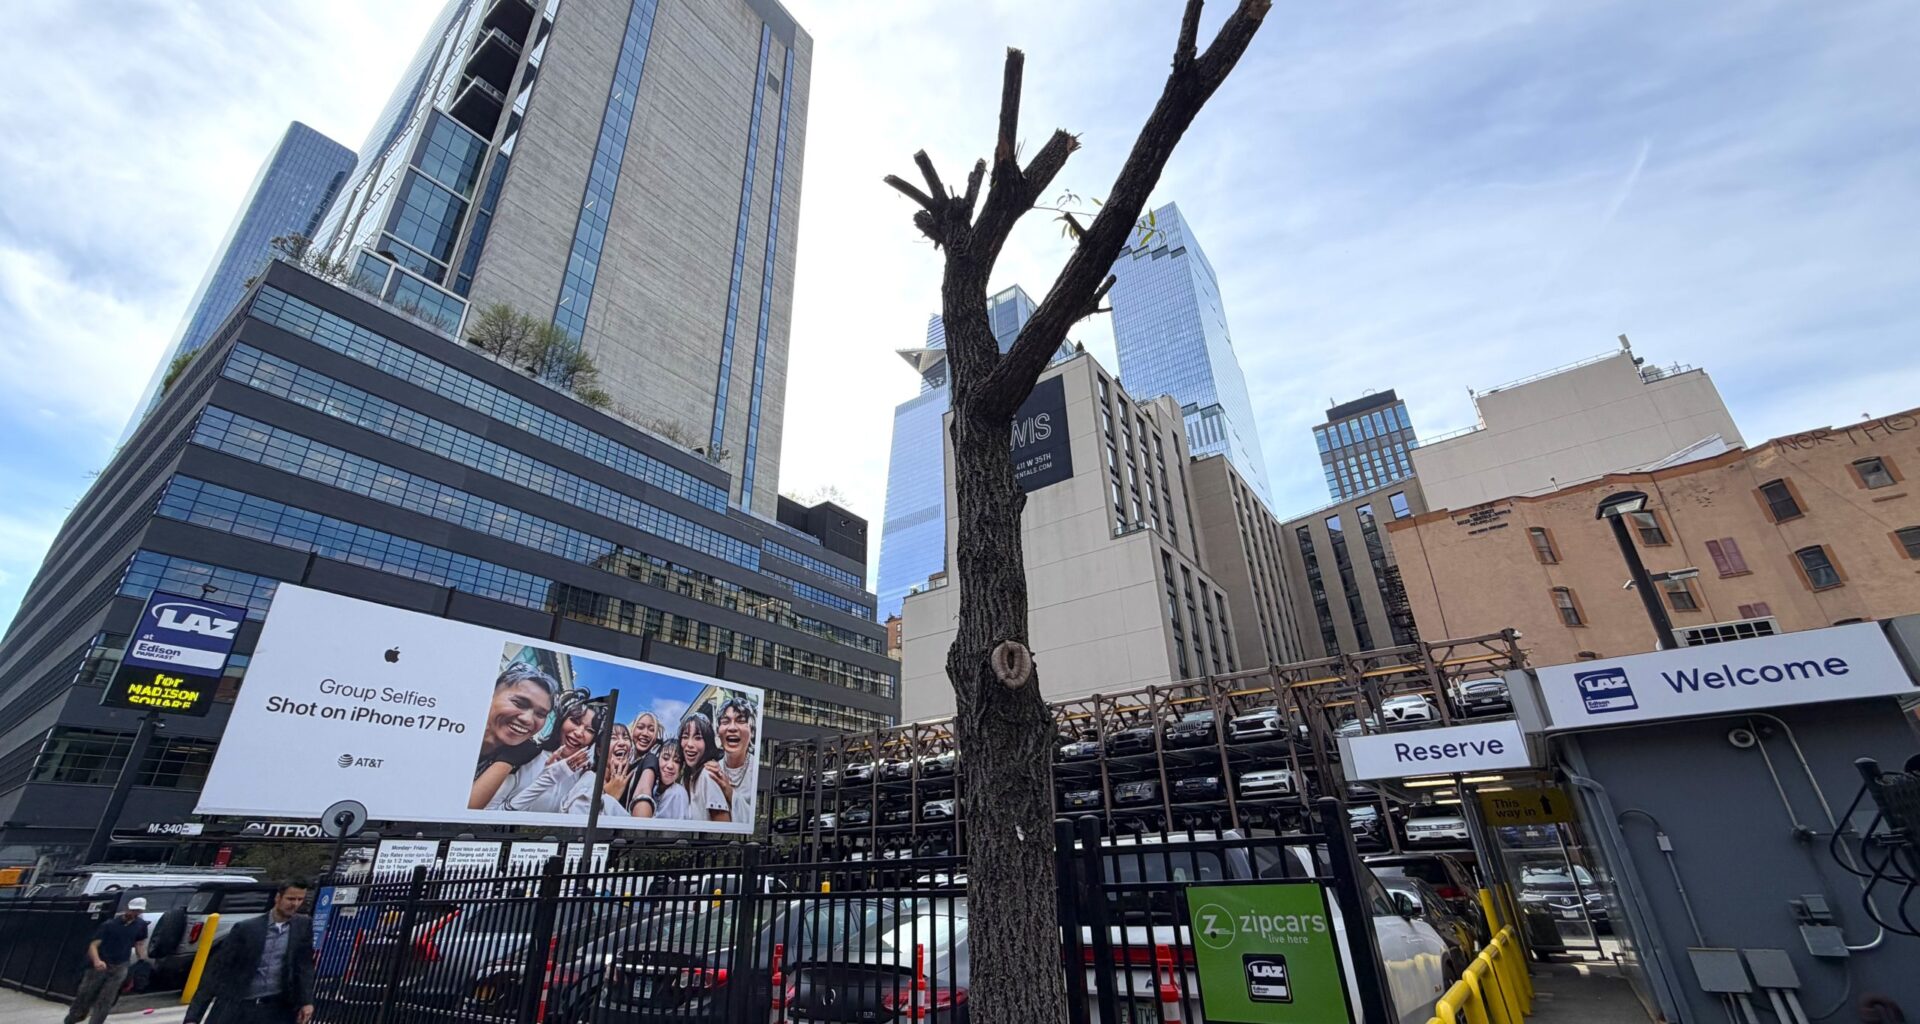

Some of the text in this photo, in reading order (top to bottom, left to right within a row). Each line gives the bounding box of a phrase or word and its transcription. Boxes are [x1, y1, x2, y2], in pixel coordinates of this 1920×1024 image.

[1026, 459, 1033, 467] W
[1034, 452, 1051, 464] 35TH
[157, 607, 239, 640] LAZ
[138, 643, 181, 656] Edison
[154, 673, 183, 687] for
[1661, 656, 1850, 694] Welcome
[1584, 676, 1628, 692] LAZ
[127, 684, 199, 702] MADISON
[320, 678, 436, 708] Group Selfies
[266, 696, 465, 734] Shot on iPhone 17 Pro
[1394, 737, 1504, 762] Reserve
[354, 758, 384, 768] AT&T
[1492, 798, 1519, 809] This
[1496, 808, 1536, 818] way in
[147, 824, 182, 834] M-340
[247, 823, 328, 837] UTFRO
[1239, 909, 1326, 938] zipcars
[1268, 935, 1308, 944] live here
[1252, 966, 1284, 978] LAZ
